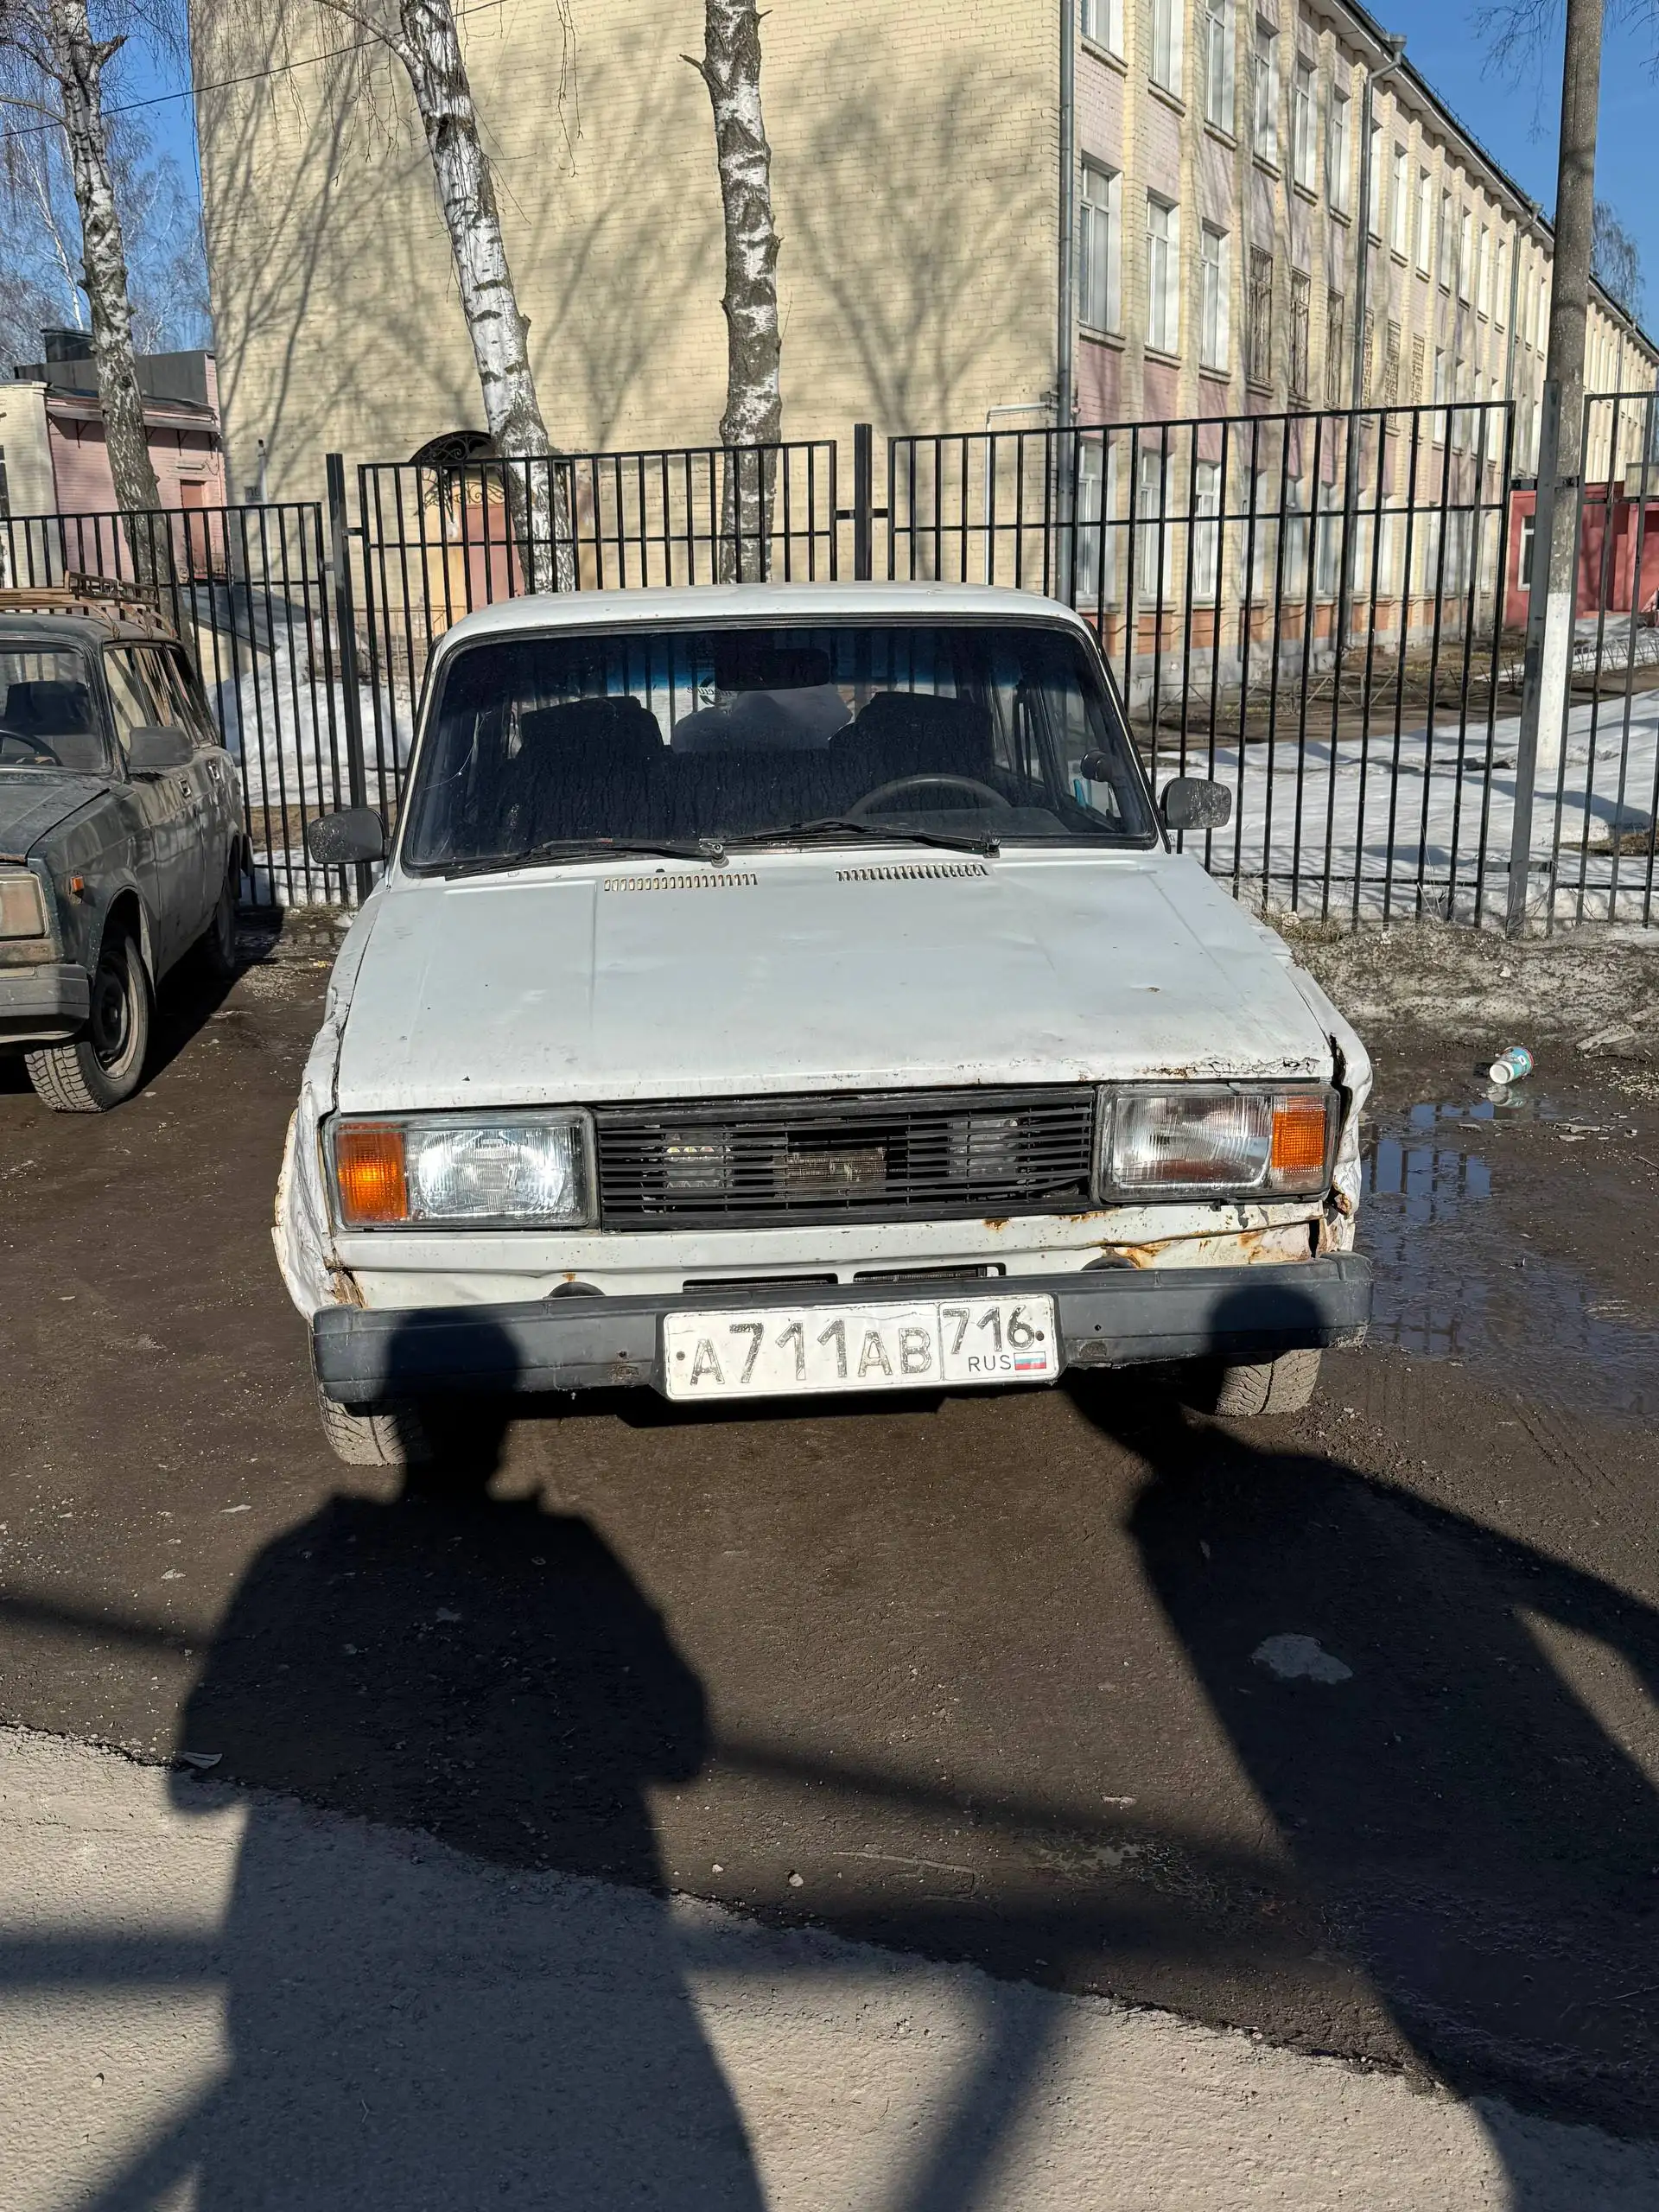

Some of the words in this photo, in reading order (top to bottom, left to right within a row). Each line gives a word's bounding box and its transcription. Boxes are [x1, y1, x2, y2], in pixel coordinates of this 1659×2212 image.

[690, 1319, 932, 1386] A711AB
[942, 1304, 1034, 1355] 716
[967, 1354, 1012, 1373] RUS
